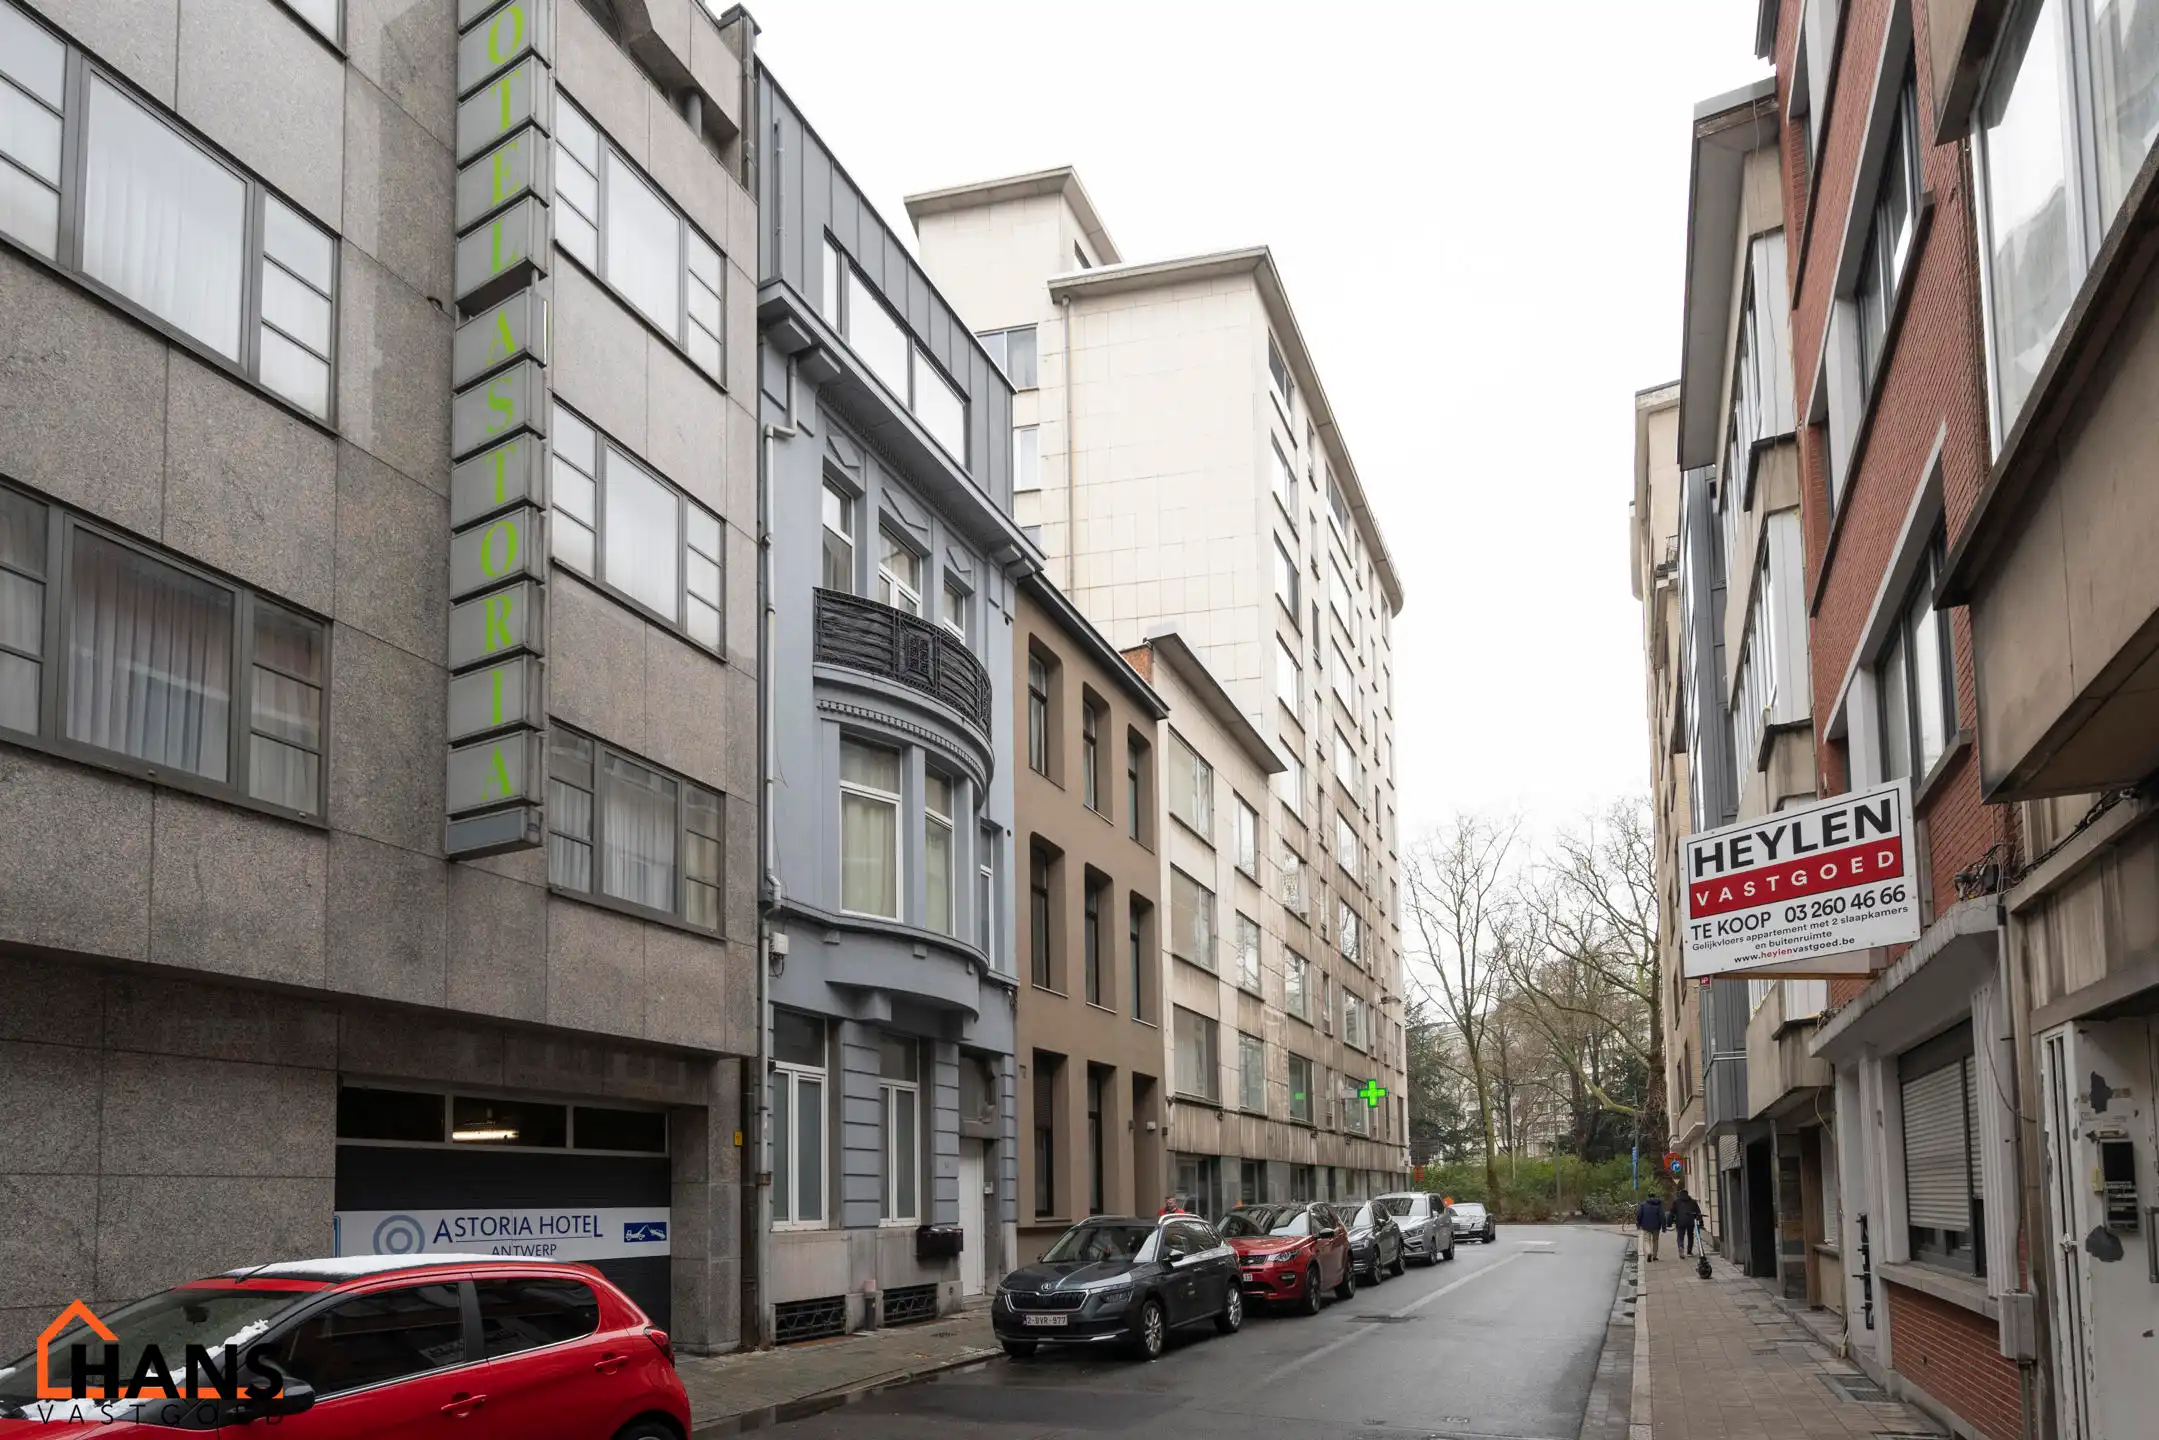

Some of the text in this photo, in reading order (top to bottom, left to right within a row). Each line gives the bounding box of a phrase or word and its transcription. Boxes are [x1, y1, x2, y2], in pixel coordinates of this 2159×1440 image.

[480, 0, 524, 800] OTEL ASTORIA
[1694, 799, 1892, 878] HEYLEN
[1696, 851, 1894, 907] VASTGOED
[1690, 884, 1906, 941] TE KOOP 03 260 46 66
[1692, 905, 1909, 951] Gelijkvloers appartement met 2 slaapkamers
[1734, 937, 1855, 963] www.heylenvastgoed.be
[1755, 931, 1832, 950] en buitenruimte
[432, 1215, 604, 1244] ASTORIA HOTEL
[492, 1243, 557, 1257] ANTWERP
